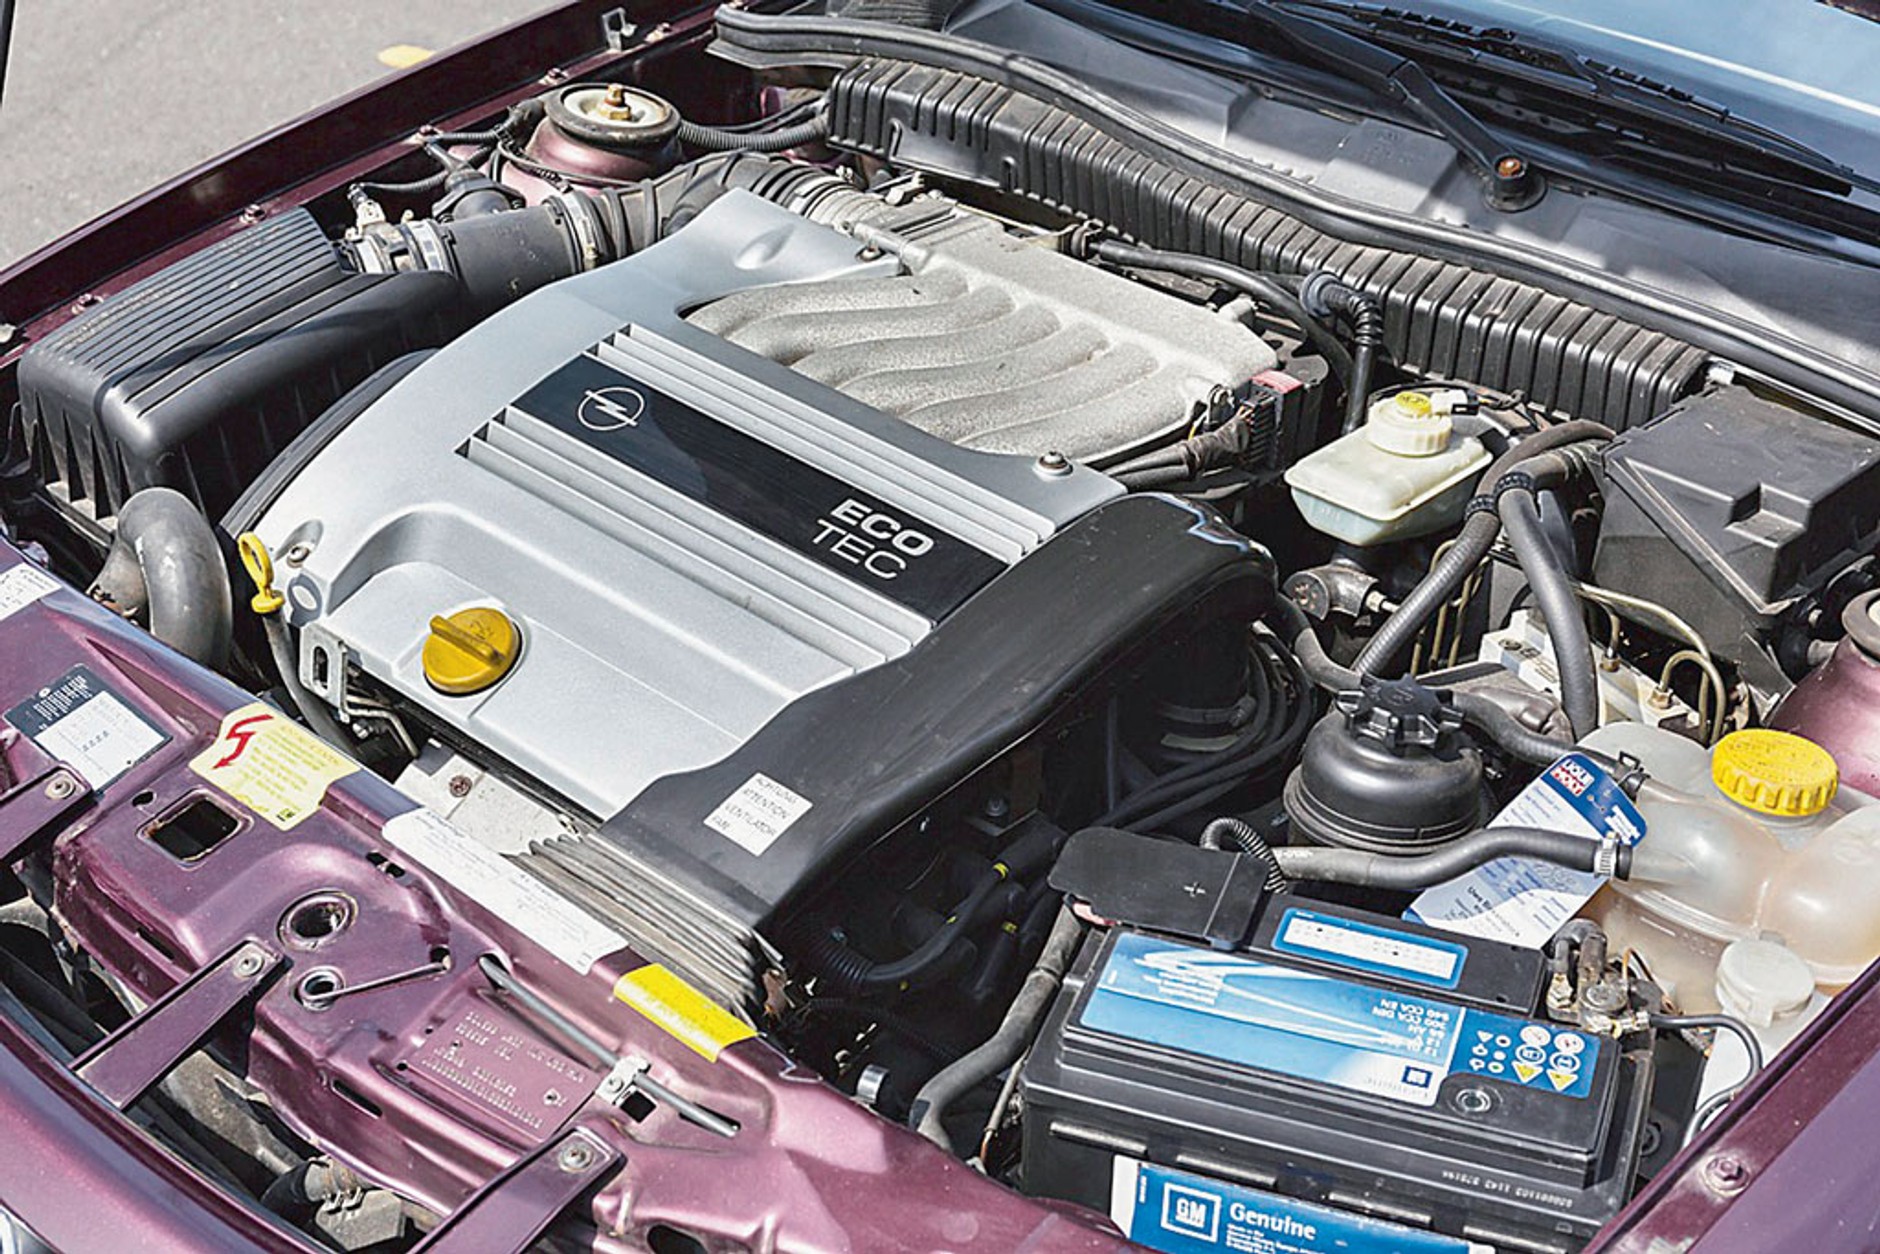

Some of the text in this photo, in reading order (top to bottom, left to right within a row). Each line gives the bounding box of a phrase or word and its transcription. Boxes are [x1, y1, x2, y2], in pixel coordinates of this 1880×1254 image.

[812, 518, 907, 580] TEC
[830, 498, 935, 557] ECO
[1175, 1197, 1207, 1223] GM
[1229, 1202, 1317, 1241] Genuine
